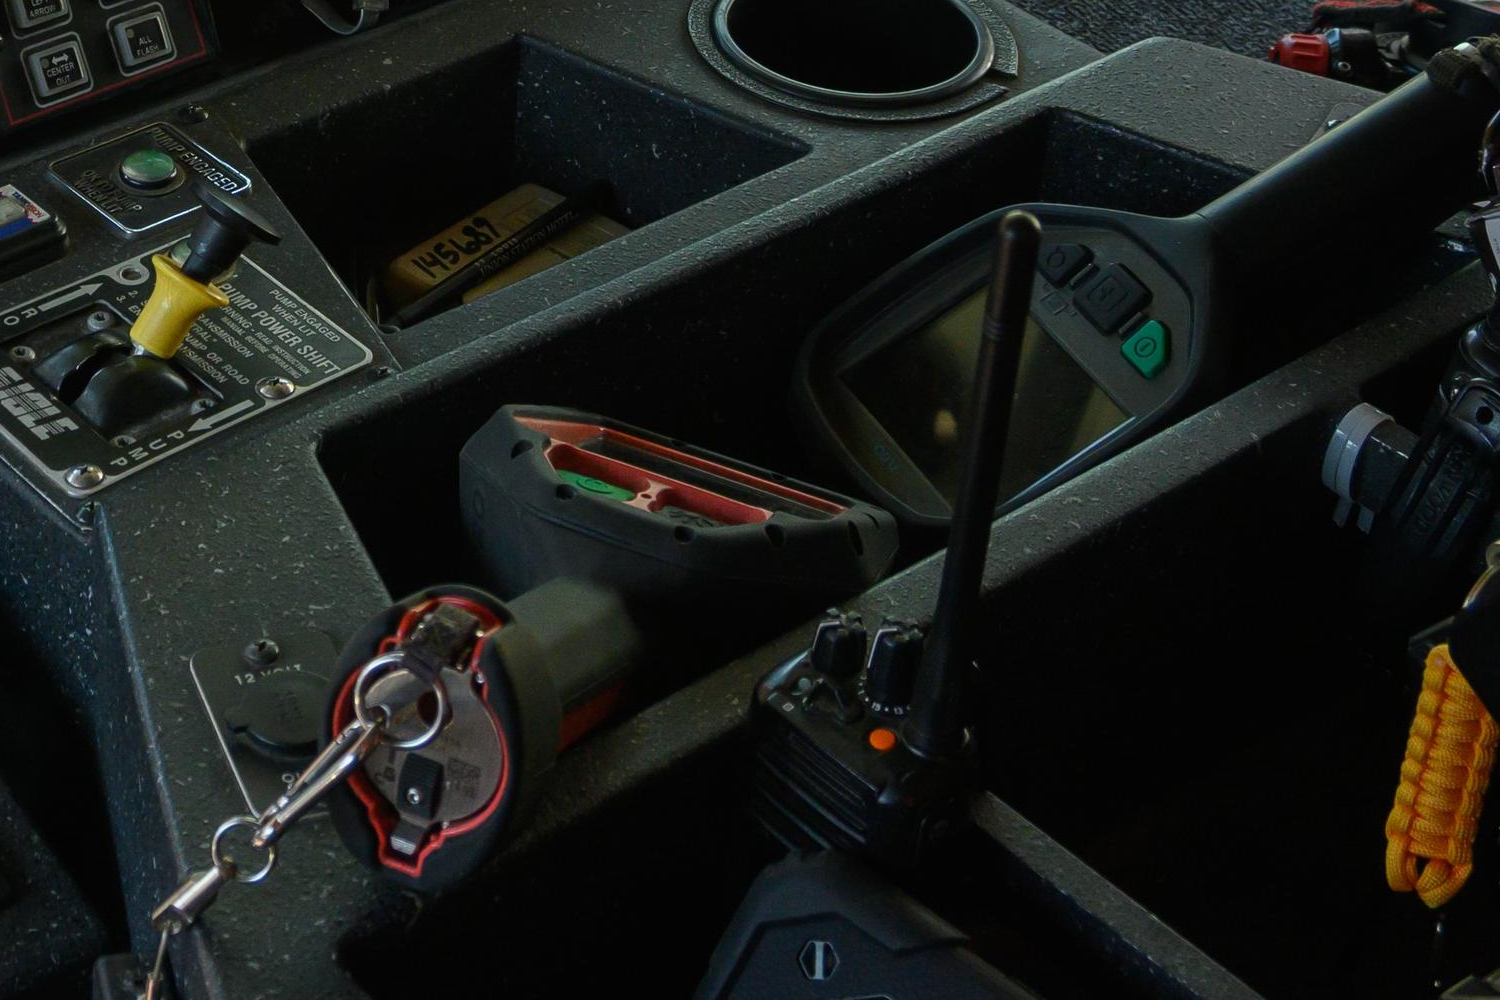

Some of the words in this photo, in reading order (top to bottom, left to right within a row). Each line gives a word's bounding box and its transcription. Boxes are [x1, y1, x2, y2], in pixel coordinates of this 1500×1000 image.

[29, 5, 55, 18] ARROW
[136, 44, 159, 57] FLASH
[138, 35, 153, 46] ALL
[46, 61, 75, 78] CENTER
[56, 75, 71, 86] OUT
[147, 126, 186, 156] PUMP
[180, 152, 238, 192] ENGAGED
[217, 283, 258, 310] PUMP
[252, 310, 302, 347] POWER
[297, 345, 341, 374] SHIFT
[269, 289, 298, 311] PUMP
[295, 309, 341, 342] ENGAGED
[271, 304, 300, 327] WHEN
[298, 323, 316, 337] LIT
[197, 313, 254, 358] RANSMISSION
[220, 306, 253, 329] RNING
[255, 329, 273, 345] READ
[272, 345, 311, 375] INSTRUCTION
[220, 316, 245, 336] MANUAL
[244, 335, 269, 353] BEFORE
[267, 353, 301, 379] OPERATING
[181, 346, 229, 383] NSMISSION
[206, 352, 223, 365] OR
[221, 364, 250, 385] ROAD
[110, 429, 185, 467] PUMP
[234, 672, 256, 687] 12
